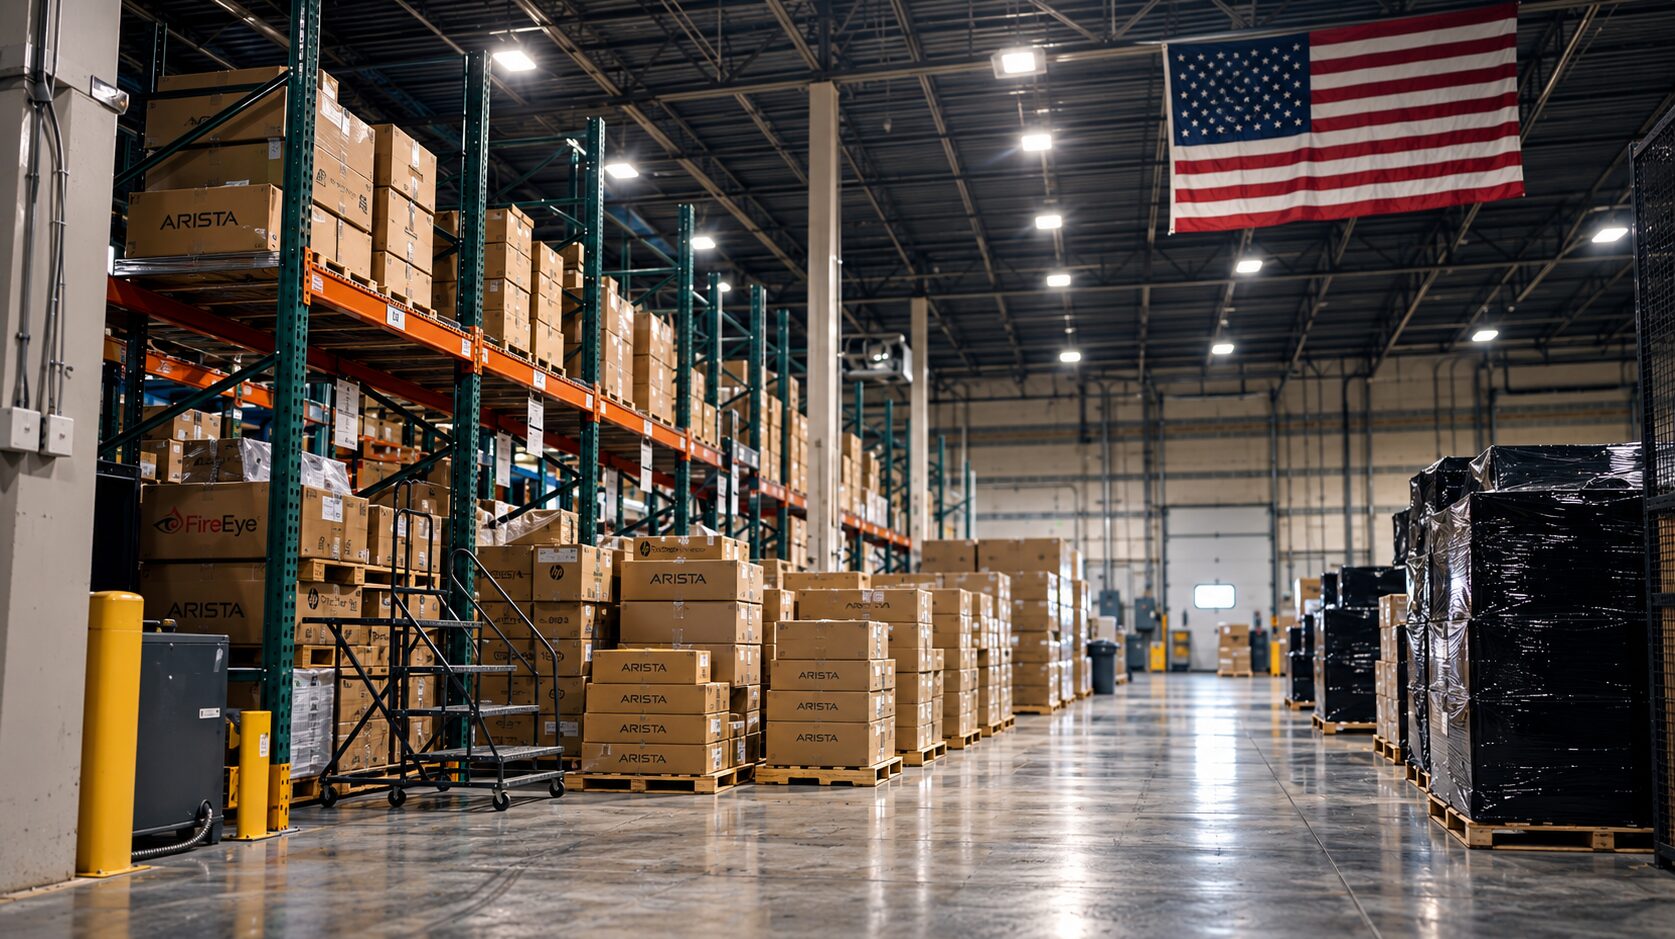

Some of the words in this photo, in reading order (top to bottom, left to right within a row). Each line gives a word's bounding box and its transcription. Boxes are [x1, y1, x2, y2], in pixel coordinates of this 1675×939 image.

[160, 210, 239, 230] ARISTA
[185, 514, 258, 537] FireEye
[549, 565, 564, 581] hp
[649, 573, 707, 585] ARISTA
[167, 602, 245, 618] ARISTA
[621, 663, 667, 672] ARISTA
[798, 671, 840, 680] ARISTA
[620, 694, 667, 704] ARISTA
[796, 702, 839, 711] ARISTA
[619, 723, 667, 734] ARISTA
[795, 733, 839, 742] ARISTA
[618, 753, 667, 764] ARISTA
